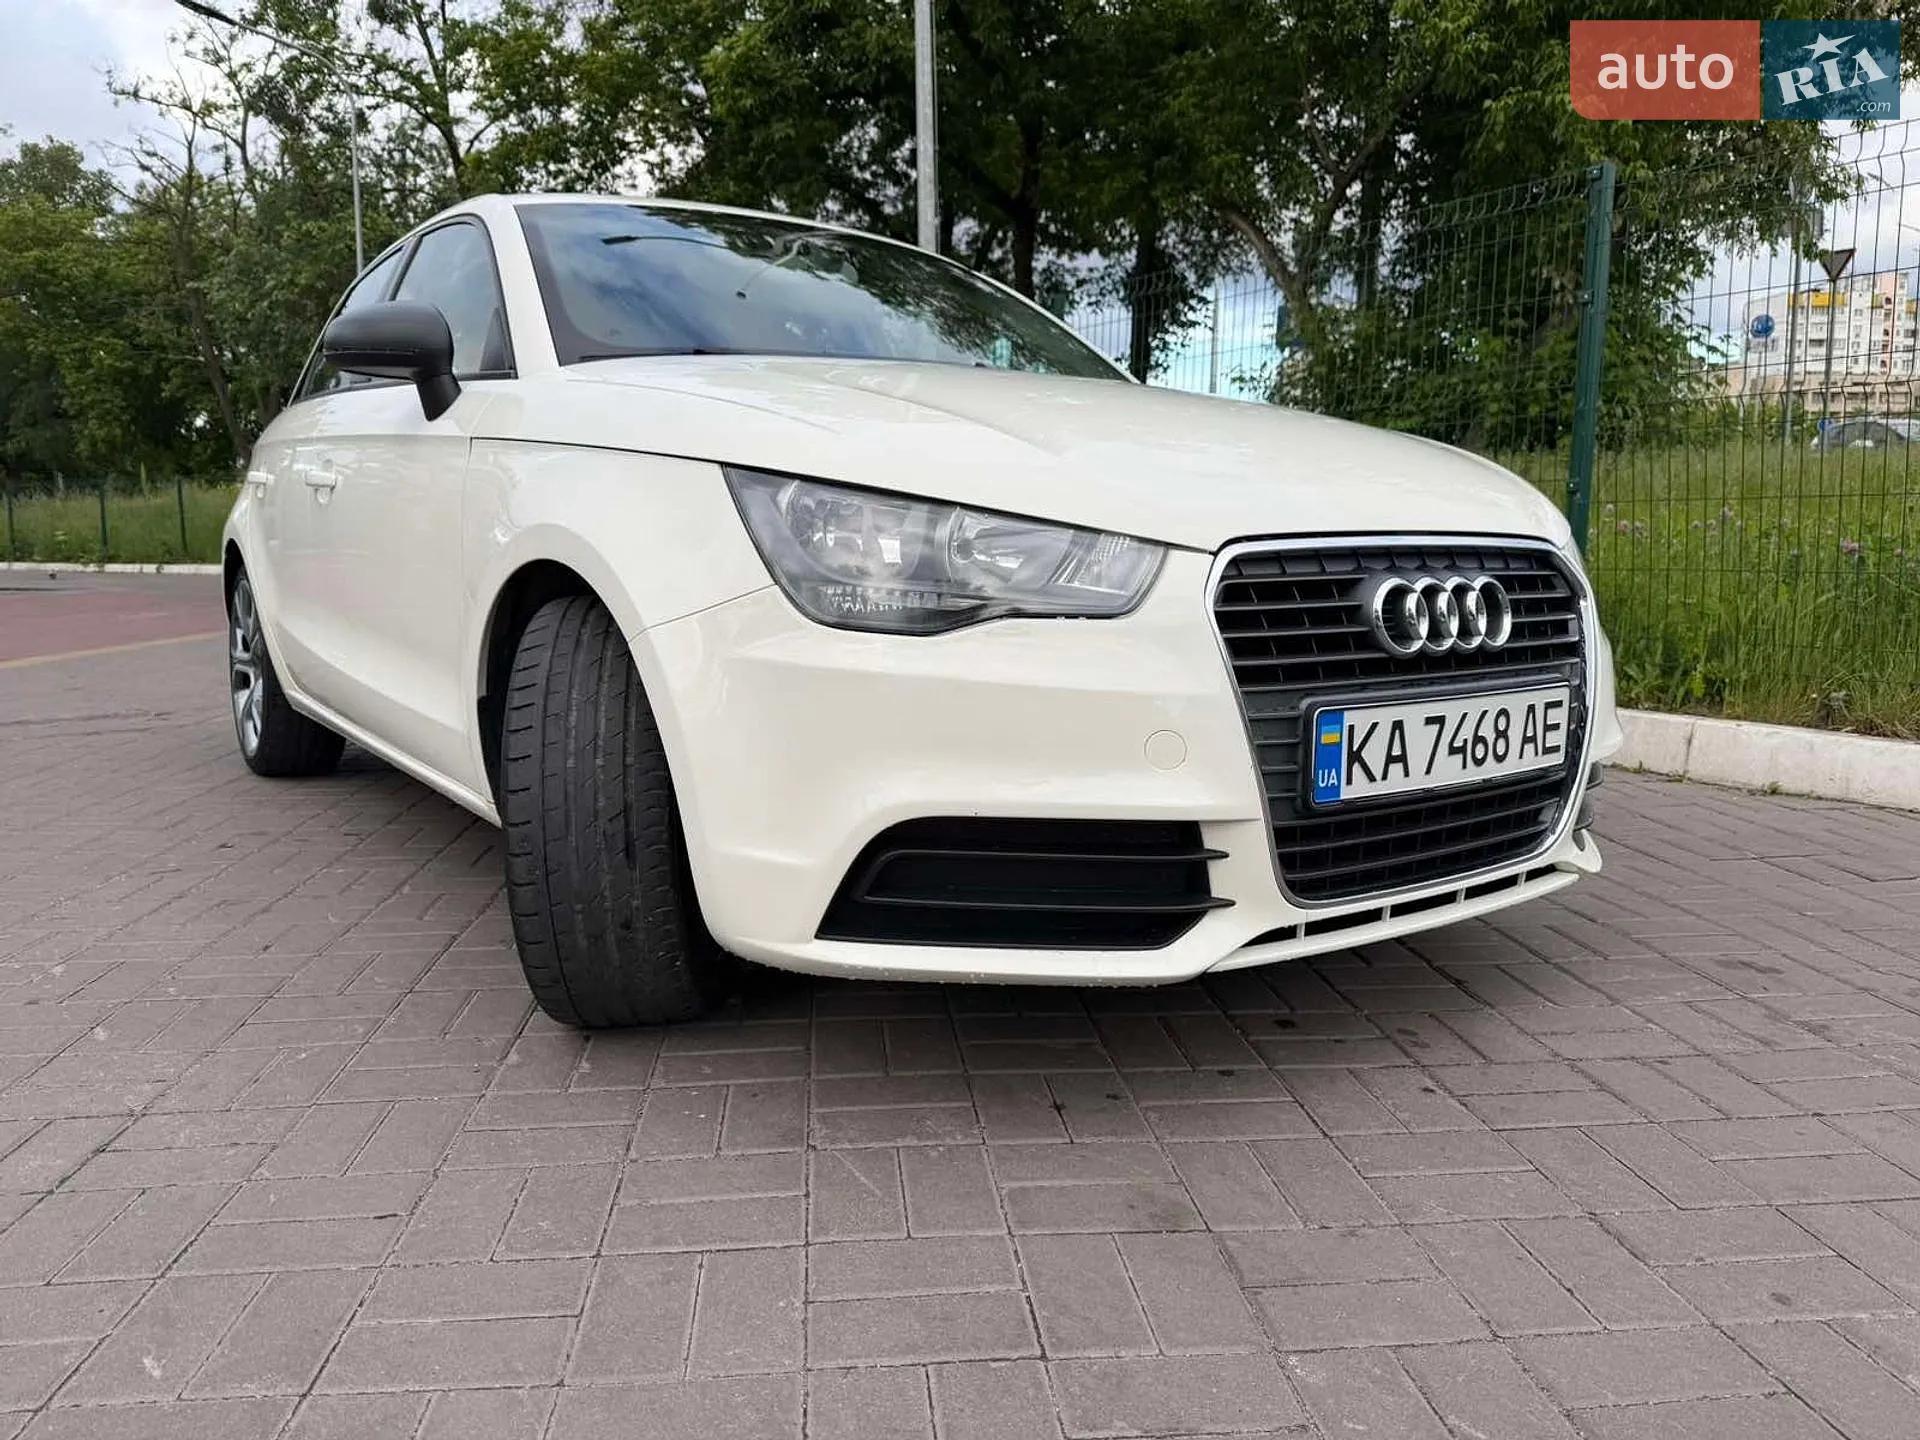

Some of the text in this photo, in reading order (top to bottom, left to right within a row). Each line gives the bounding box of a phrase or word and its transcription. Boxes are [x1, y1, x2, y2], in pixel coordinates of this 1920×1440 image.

[1345, 699, 1564, 785] KA 7468 AE
[1318, 768, 1338, 788] UA
